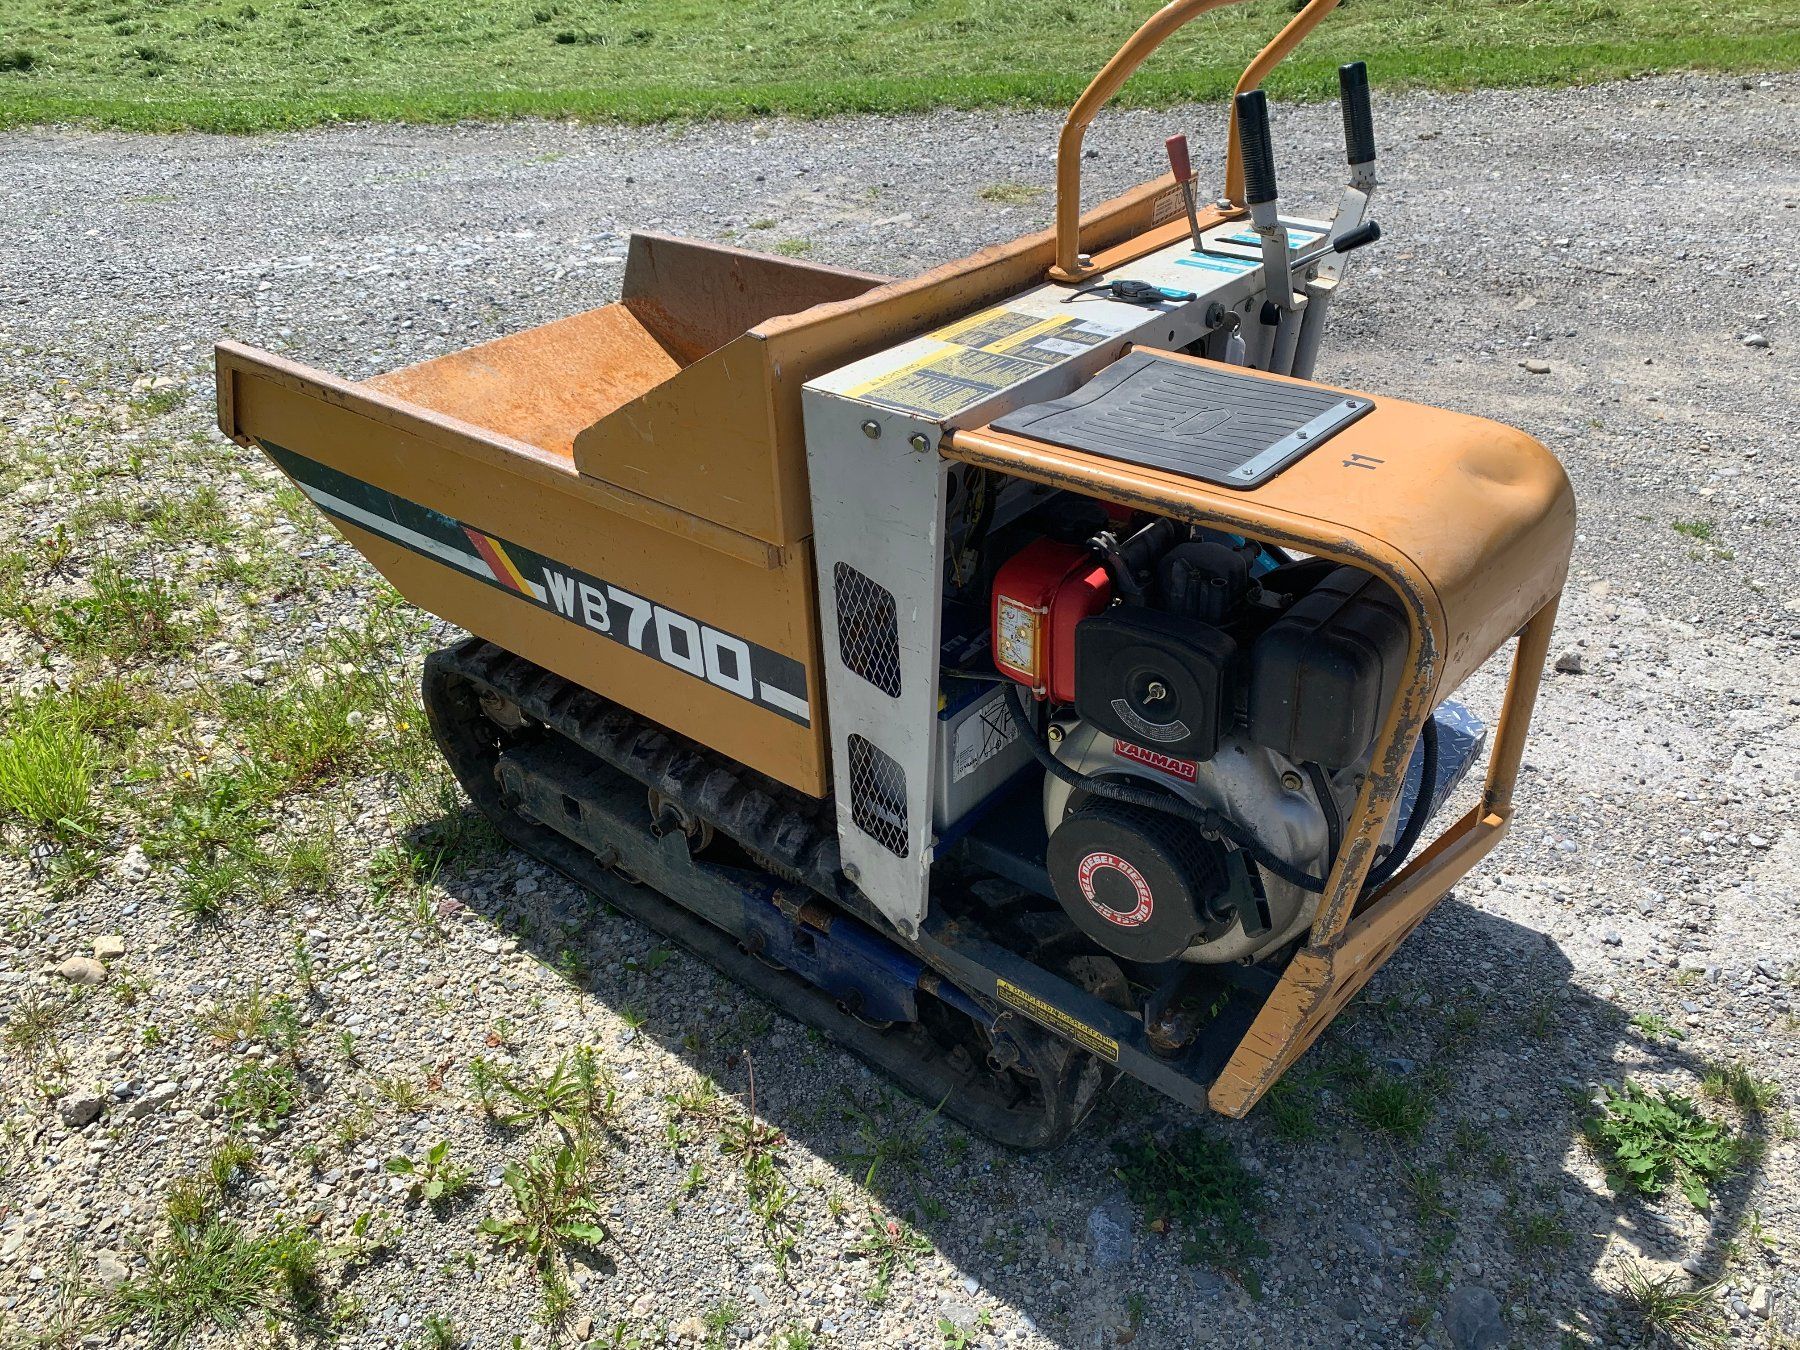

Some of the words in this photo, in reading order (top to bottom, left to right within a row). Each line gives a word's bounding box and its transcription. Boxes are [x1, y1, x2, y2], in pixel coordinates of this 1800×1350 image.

[1342, 453, 1385, 470] 11
[1117, 739, 1194, 777] YANMAR
[1082, 856, 1114, 875] DIESEL
[1118, 862, 1149, 902] DIESEL
[1013, 987, 1045, 1009] DANGER
[1080, 1024, 1113, 1046] GEFAHR
